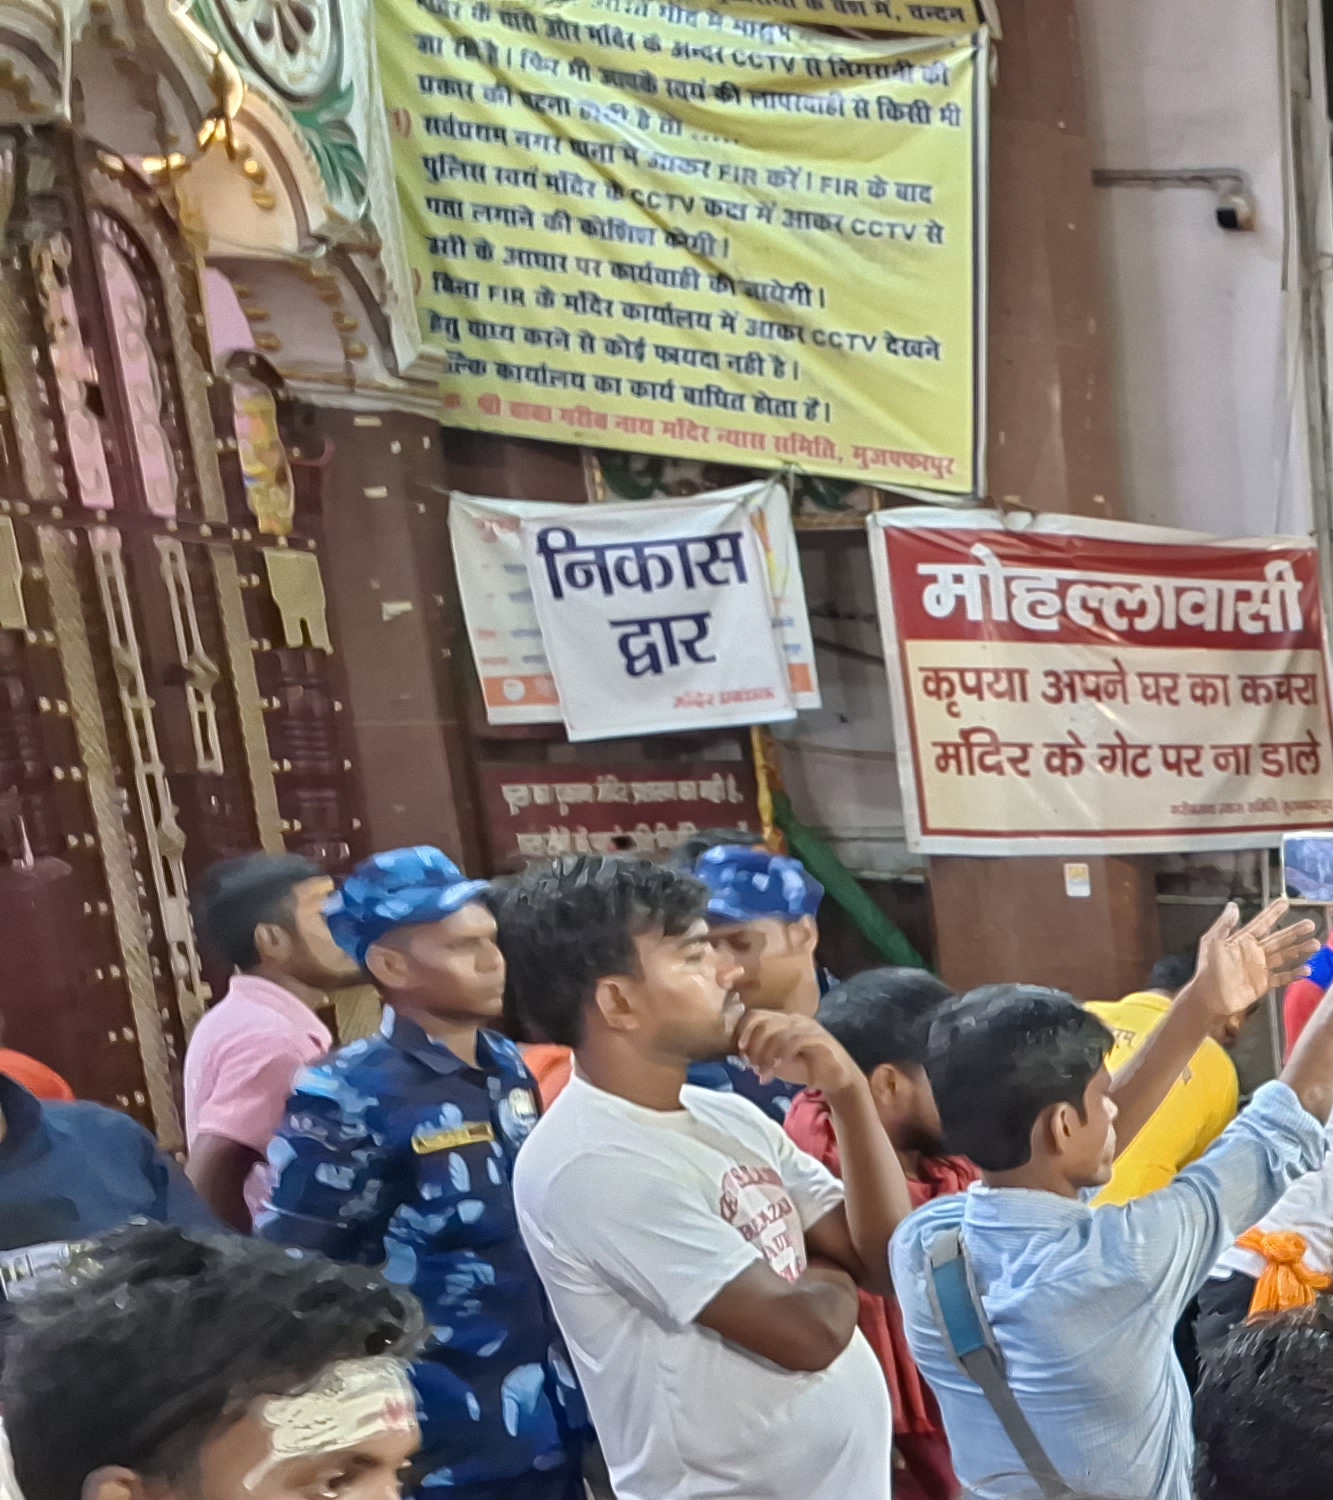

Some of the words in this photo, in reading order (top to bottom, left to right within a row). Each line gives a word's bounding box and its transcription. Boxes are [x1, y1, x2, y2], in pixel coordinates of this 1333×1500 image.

[731, 48, 796, 73] CCTV
[875, 95, 932, 124] किसी
[939, 101, 962, 126] भी
[513, 129, 561, 154] नगर
[718, 164, 758, 187] FIR
[820, 177, 858, 198] FIR
[866, 176, 888, 200] के
[471, 205, 534, 230] लगाने
[626, 188, 695, 213] CCTV
[781, 208, 843, 235] आकर
[851, 217, 917, 241] CCTV
[925, 220, 945, 245] से
[574, 256, 601, 278] पर
[607, 261, 700, 291] कार्यवाही
[488, 284, 526, 307] FIR
[534, 284, 556, 308] के
[621, 301, 713, 331] कार्यालय
[745, 317, 805, 346] आकर
[811, 328, 877, 352] CCTV
[883, 330, 942, 362] देखने
[521, 327, 571, 352] करने
[602, 332, 646, 363] कोई
[446, 350, 487, 376] ल्कि
[494, 361, 586, 392] कार्यालय
[592, 375, 622, 397] का
[629, 378, 675, 403] कार्य
[752, 391, 797, 418] होता
[536, 527, 749, 600] निकास
[916, 543, 1304, 635] मोहल्लावासी
[609, 611, 718, 679] द्वार
[918, 666, 1030, 719] कृपया
[1041, 658, 1130, 706] अपने
[1137, 672, 1180, 707] घर
[1187, 673, 1231, 707] का
[1238, 673, 1318, 707] कचरा
[1043, 730, 1087, 778] के
[1096, 730, 1153, 779] गेट
[1159, 742, 1205, 779] पर
[1209, 743, 1252, 776] ना
[1257, 729, 1322, 778] डाले
